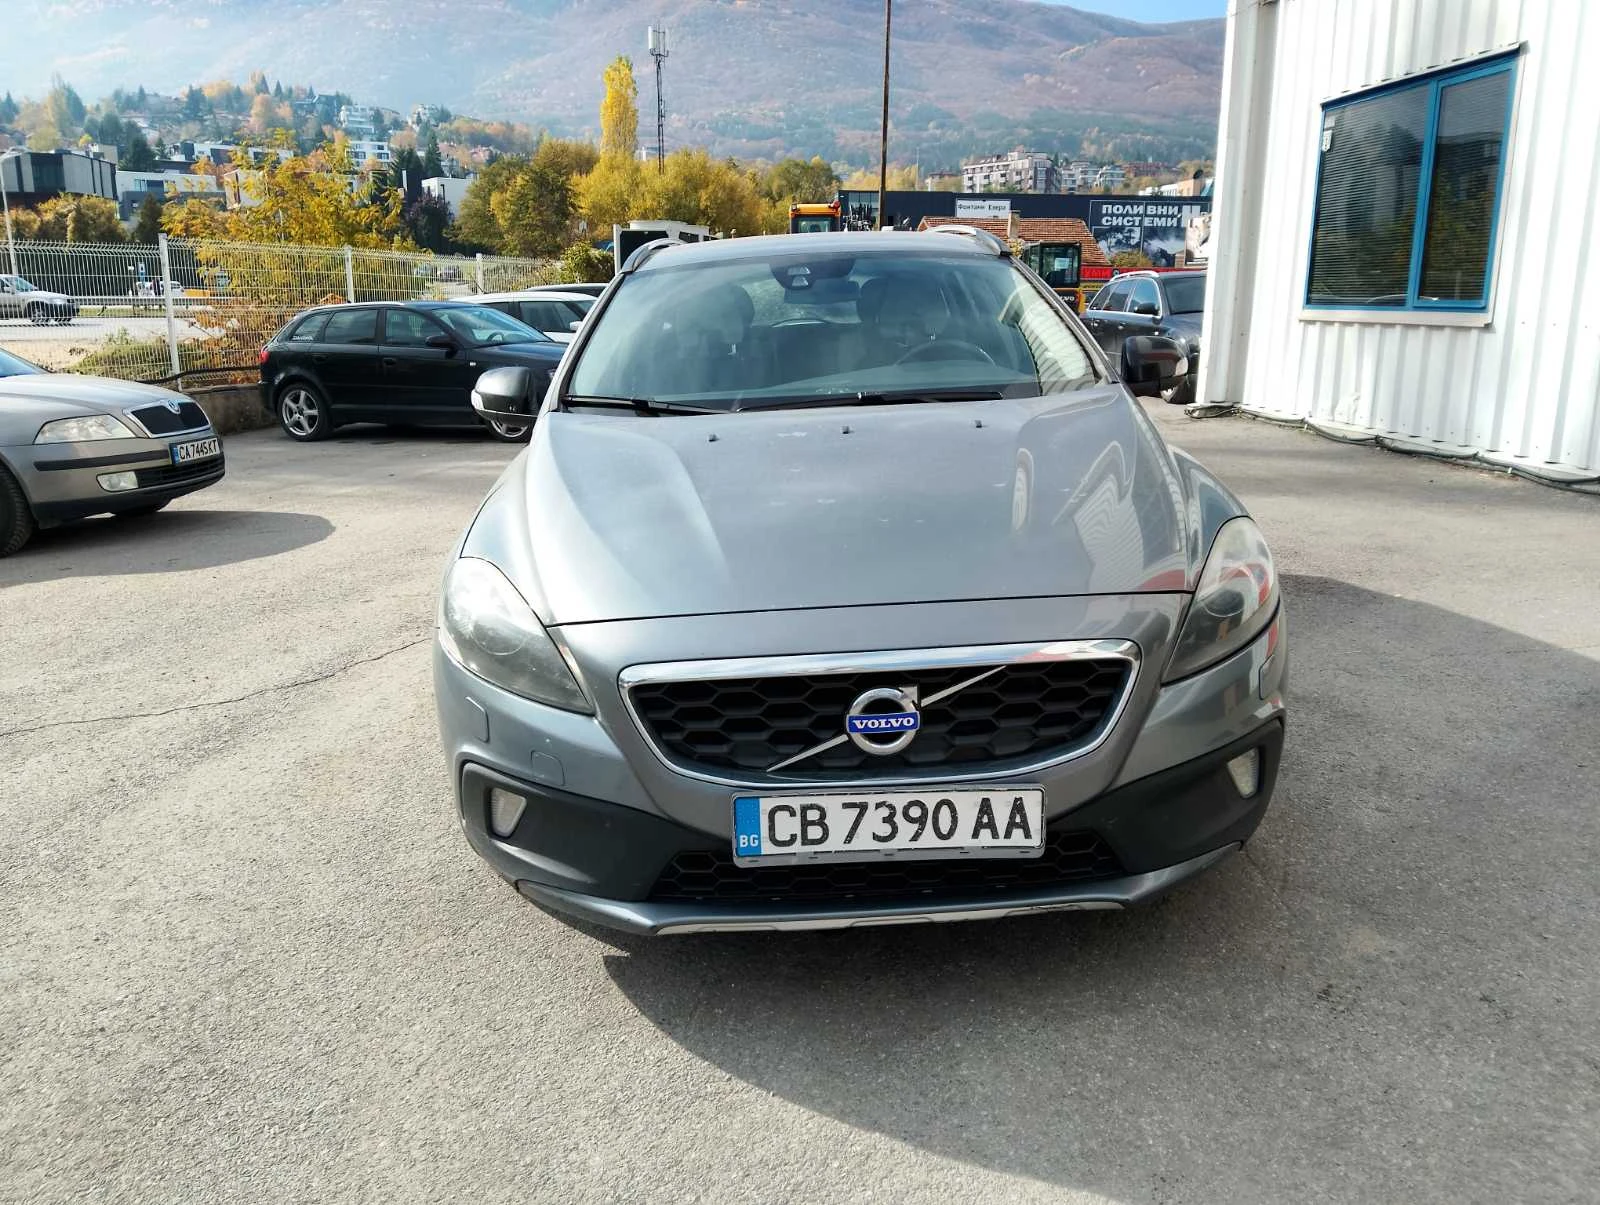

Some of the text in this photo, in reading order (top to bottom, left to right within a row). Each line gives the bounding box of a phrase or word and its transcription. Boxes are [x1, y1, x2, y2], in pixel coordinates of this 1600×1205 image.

[1102, 216, 1178, 227] СИСТЕМИ
[853, 717, 914, 729] VOLVO
[740, 797, 1032, 848] BG CB 7390 AA
